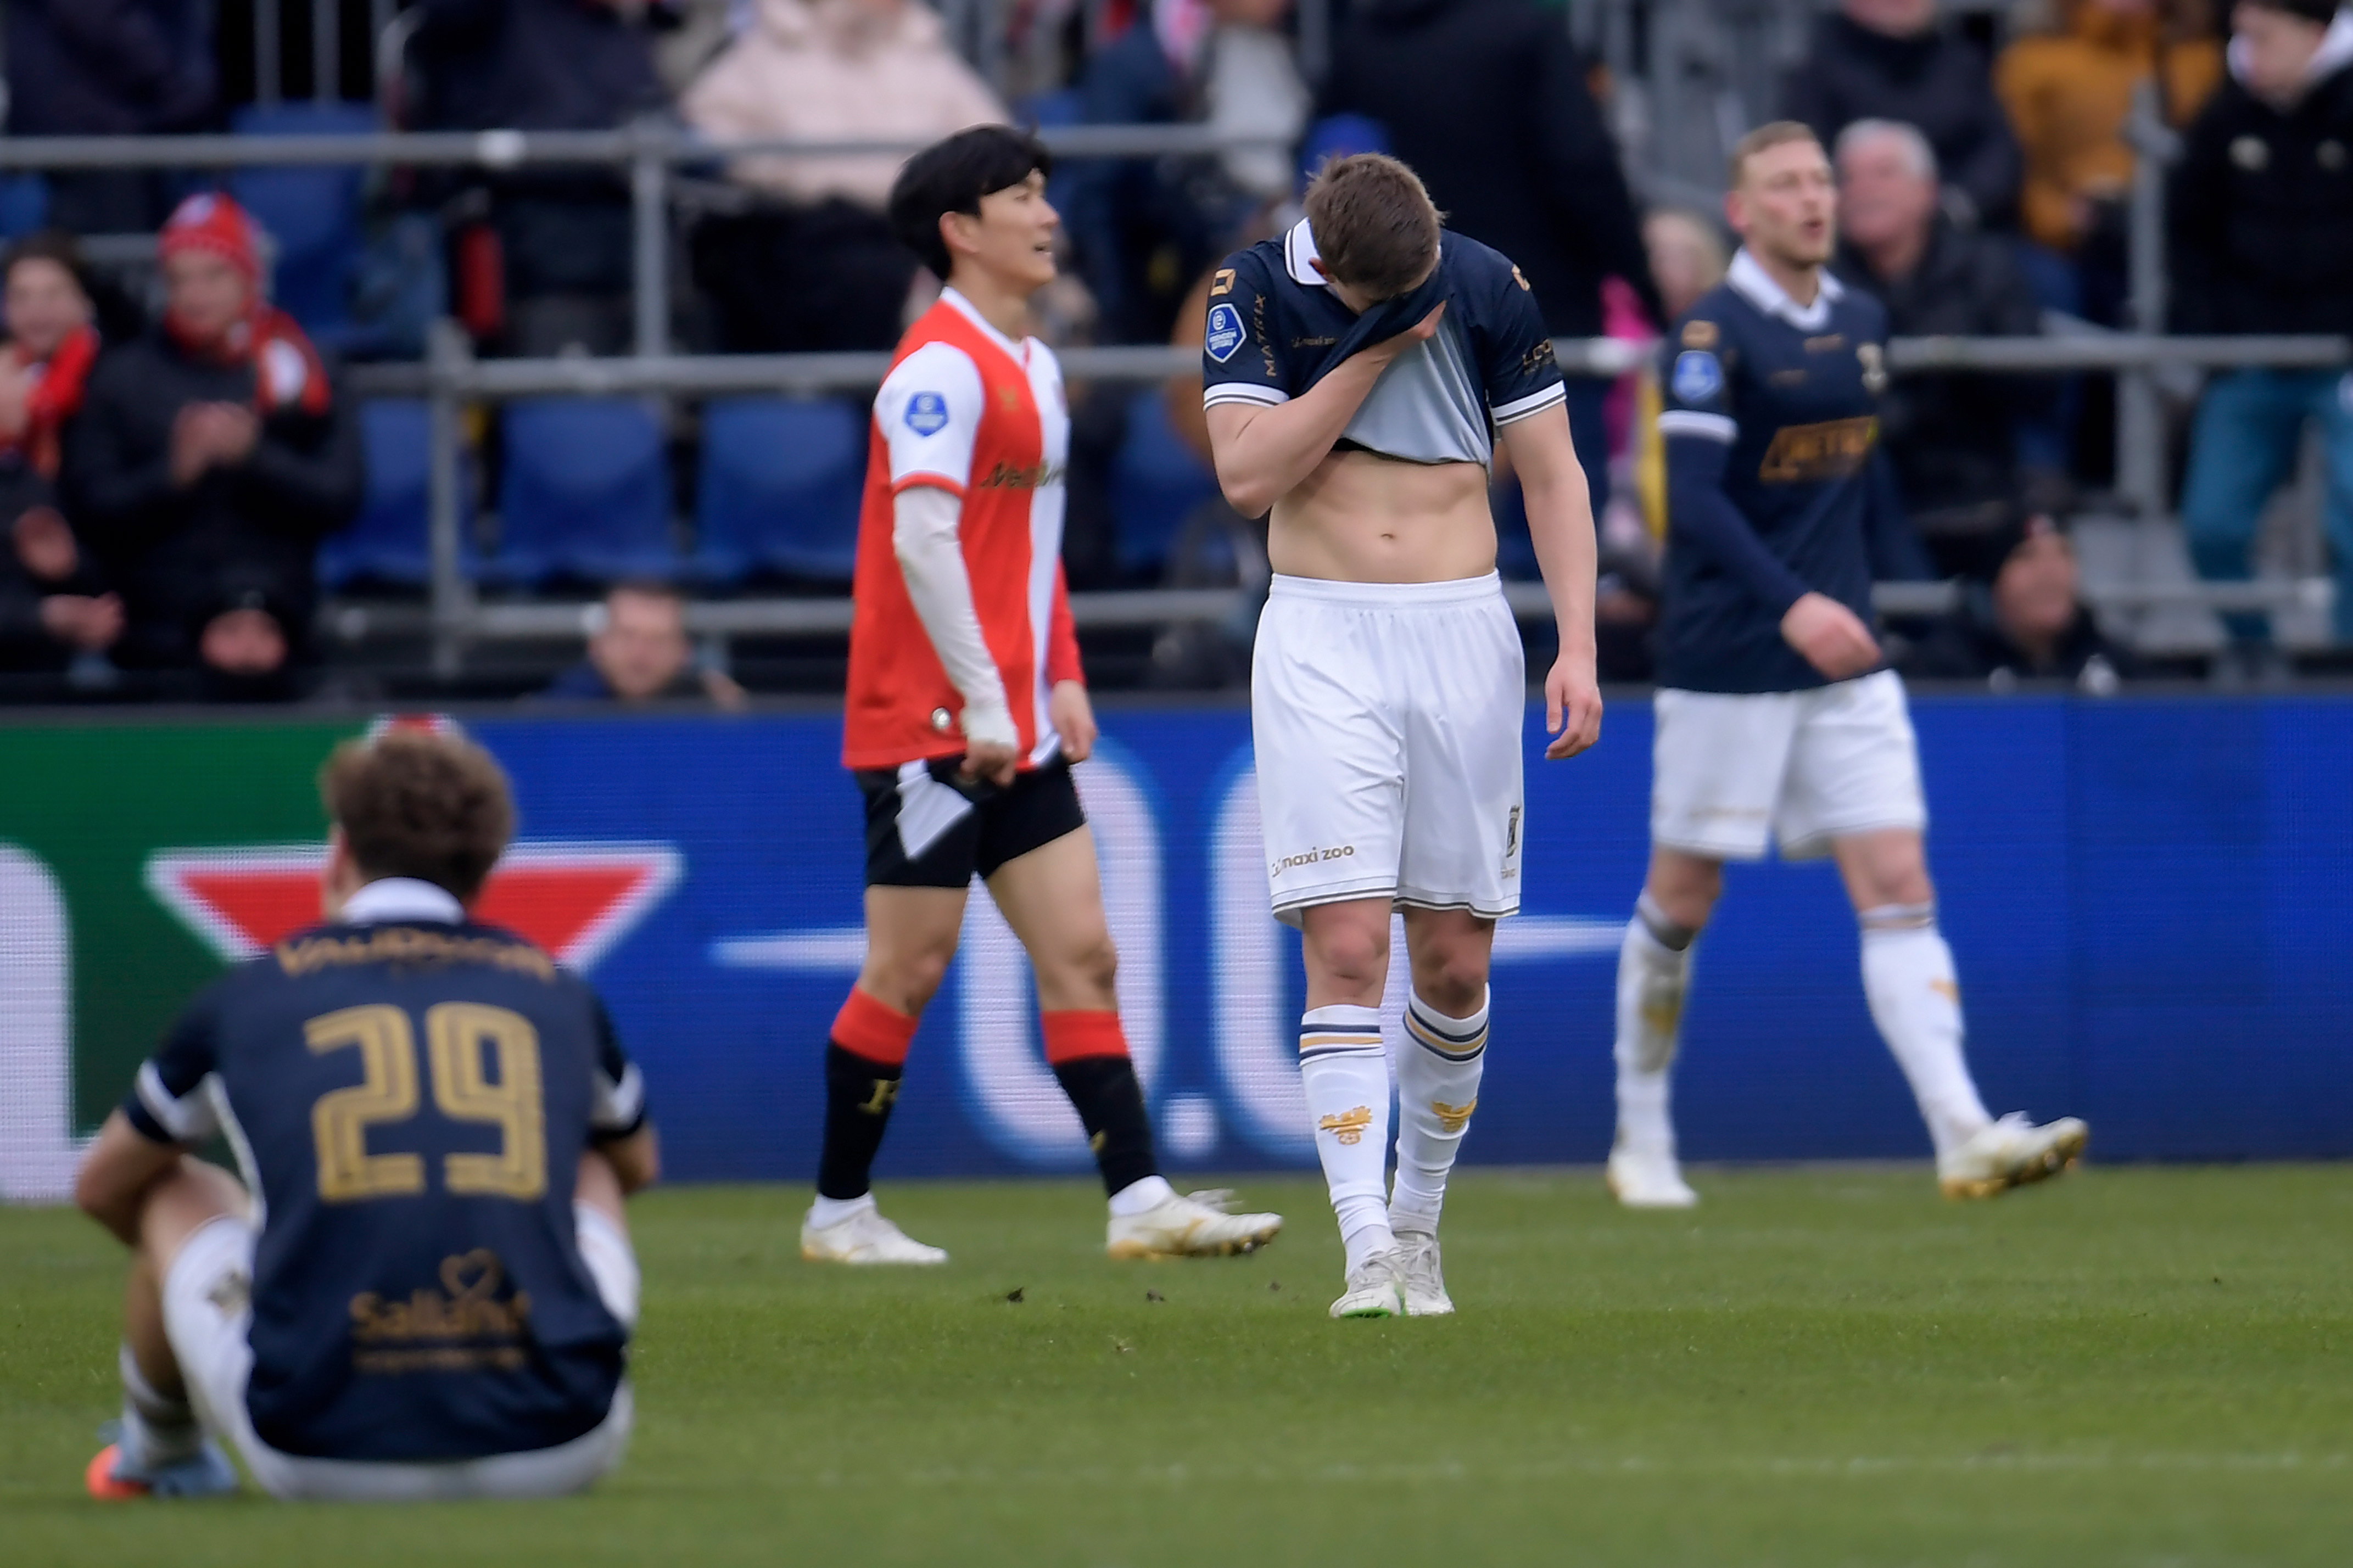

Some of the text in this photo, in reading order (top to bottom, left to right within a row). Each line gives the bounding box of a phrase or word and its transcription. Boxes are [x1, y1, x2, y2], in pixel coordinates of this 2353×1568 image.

[1254, 294, 1277, 377] MATRIX
[1282, 845, 1354, 868] maxi zoo
[303, 1001, 549, 1205] 29
